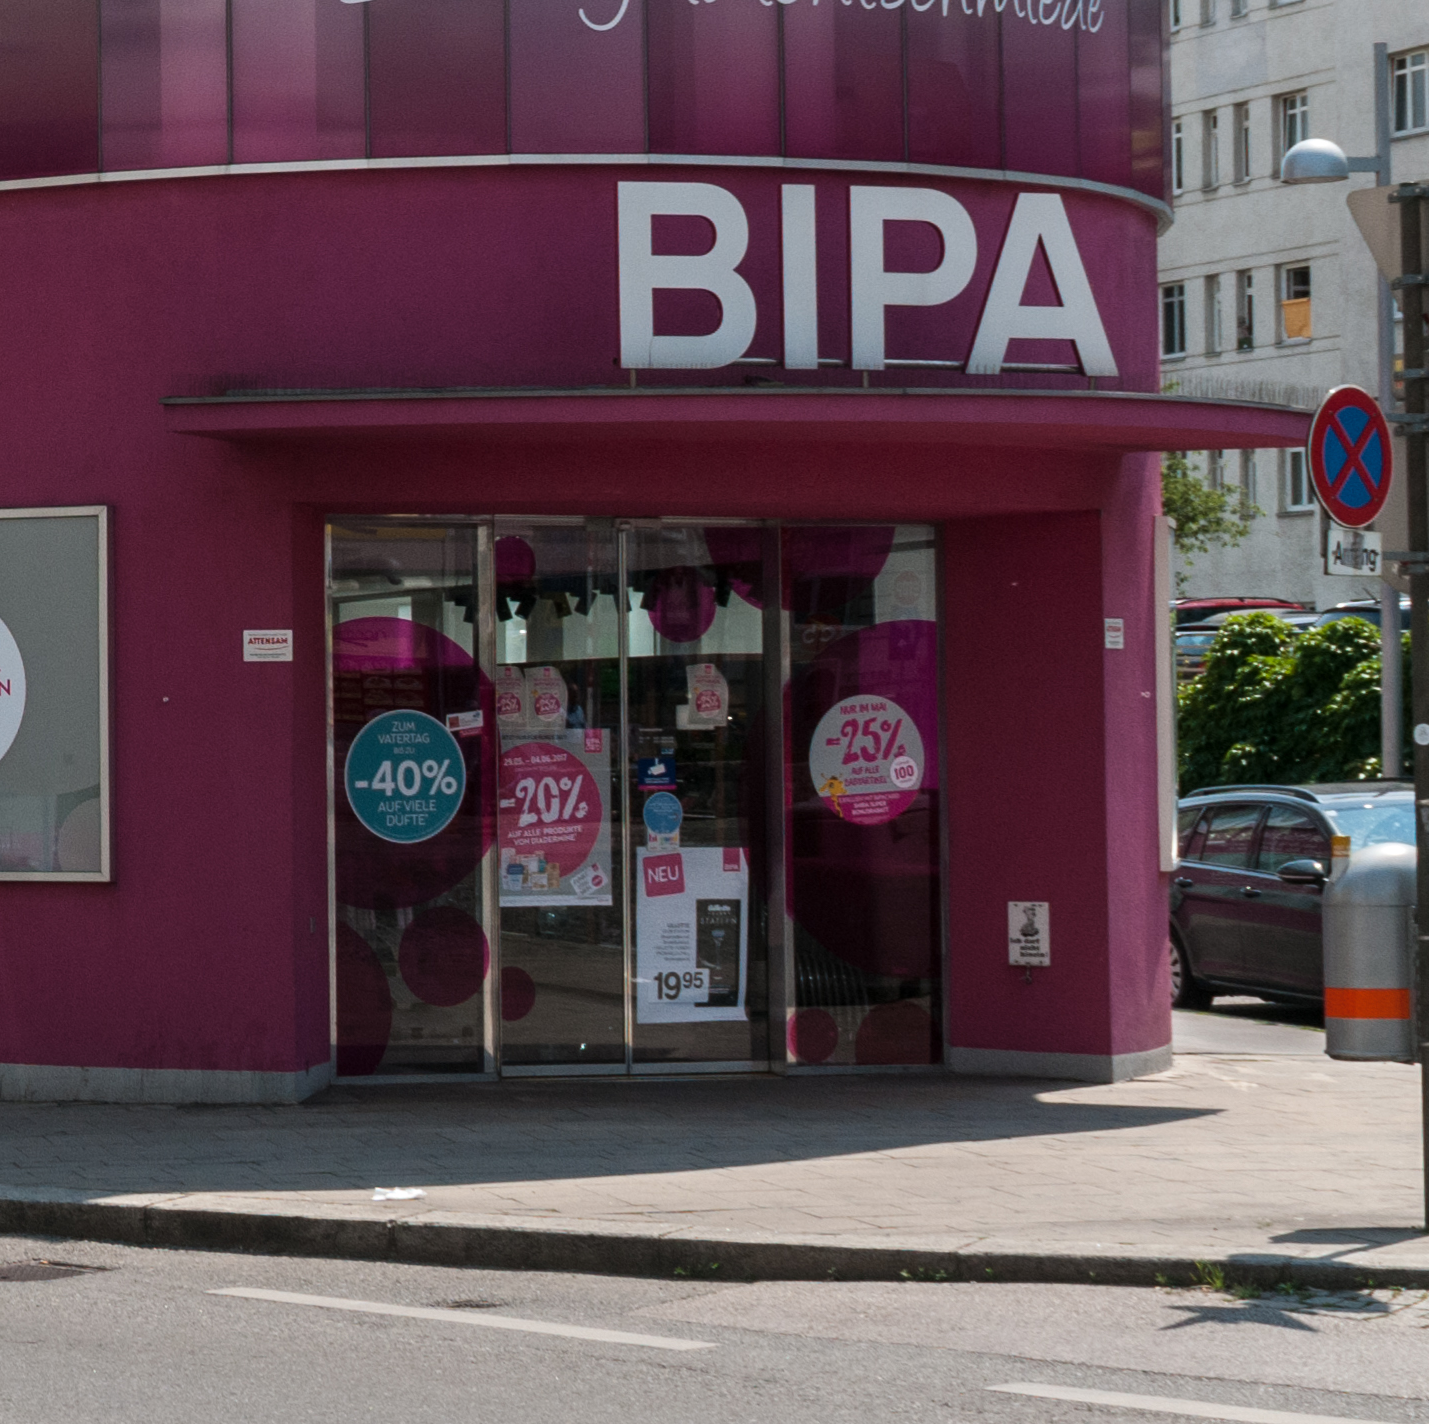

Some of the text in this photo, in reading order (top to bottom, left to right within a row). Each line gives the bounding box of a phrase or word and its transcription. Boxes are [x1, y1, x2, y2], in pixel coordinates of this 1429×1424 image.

[616, 180, 1120, 377] BIPA
[1333, 540, 1380, 573] Ang
[378, 733, 430, 744] VATERTAG
[391, 721, 416, 732] ZUM
[826, 716, 906, 765] -25%
[354, 759, 458, 797] -40%
[894, 765, 914, 780] 100
[378, 799, 437, 812] AUF VIELE
[500, 774, 589, 828] -20%
[647, 865, 679, 884] NEU
